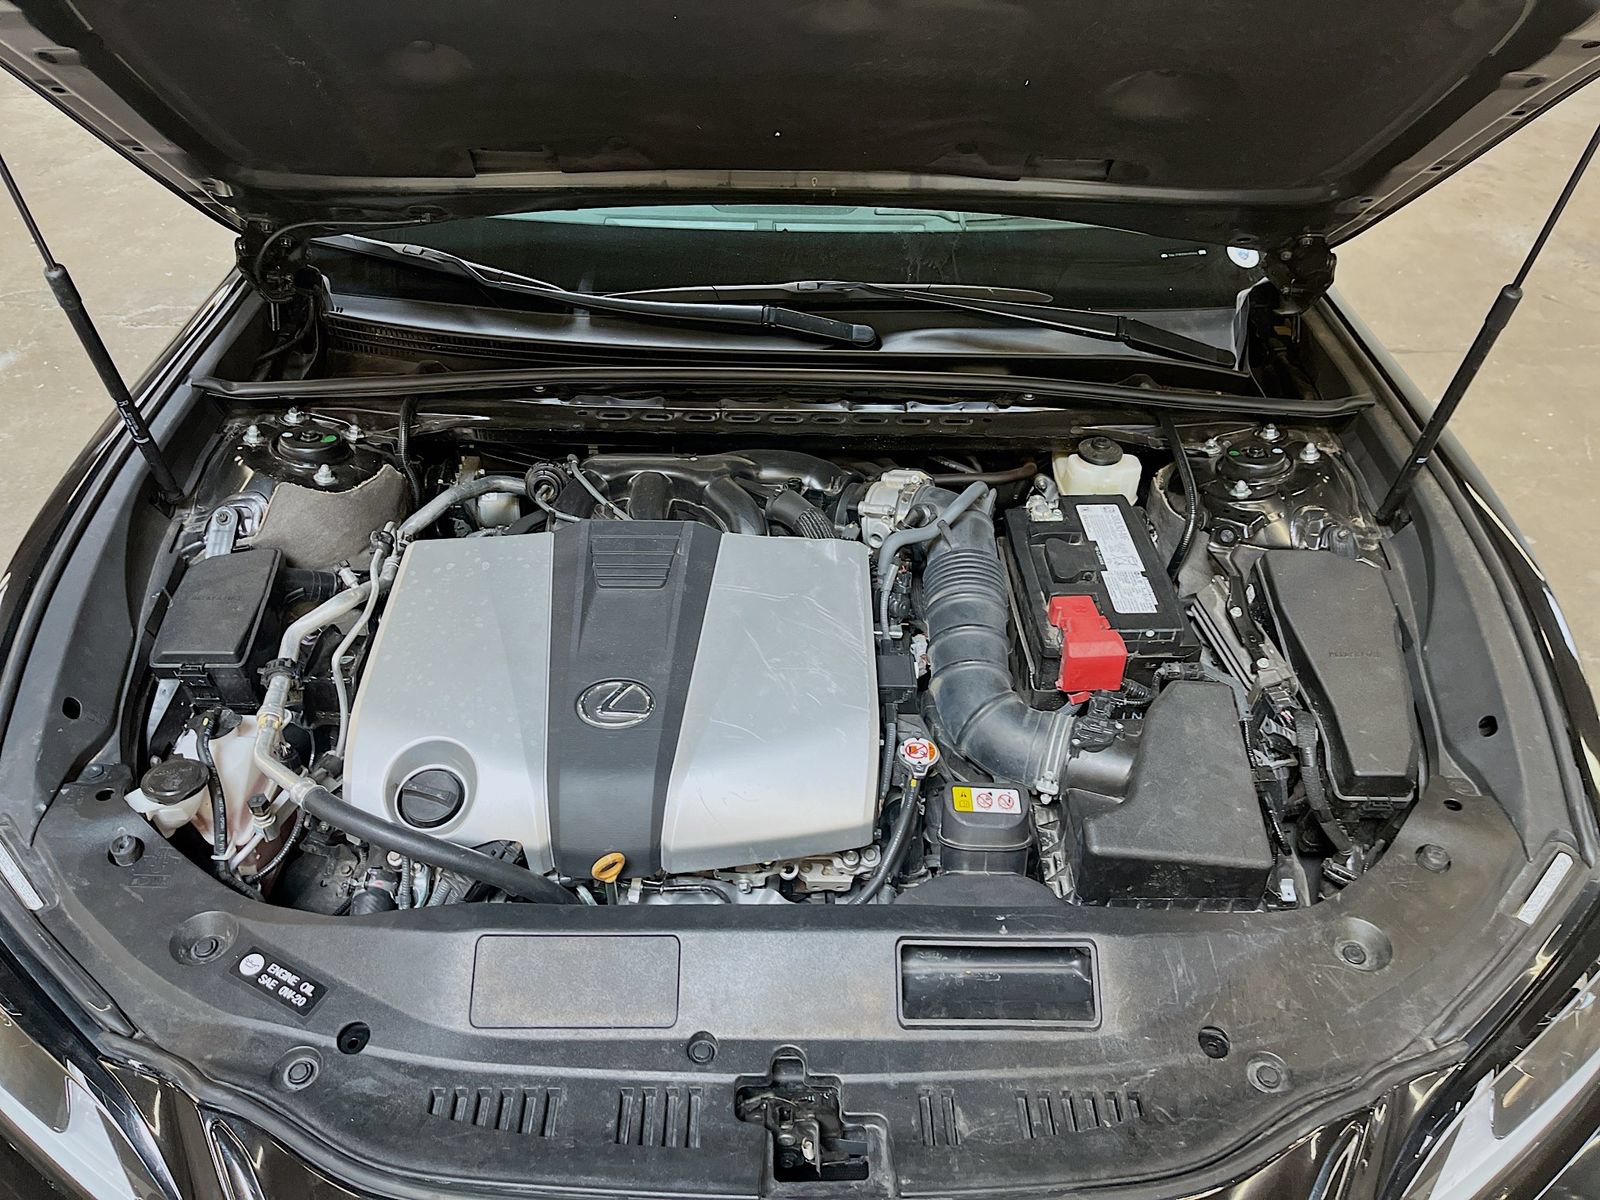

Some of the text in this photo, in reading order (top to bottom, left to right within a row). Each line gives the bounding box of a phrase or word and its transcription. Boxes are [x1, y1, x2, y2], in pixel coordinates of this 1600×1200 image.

[258, 974, 307, 1007] SAE 0W-20
[267, 963, 315, 997] ENGINE OIL
